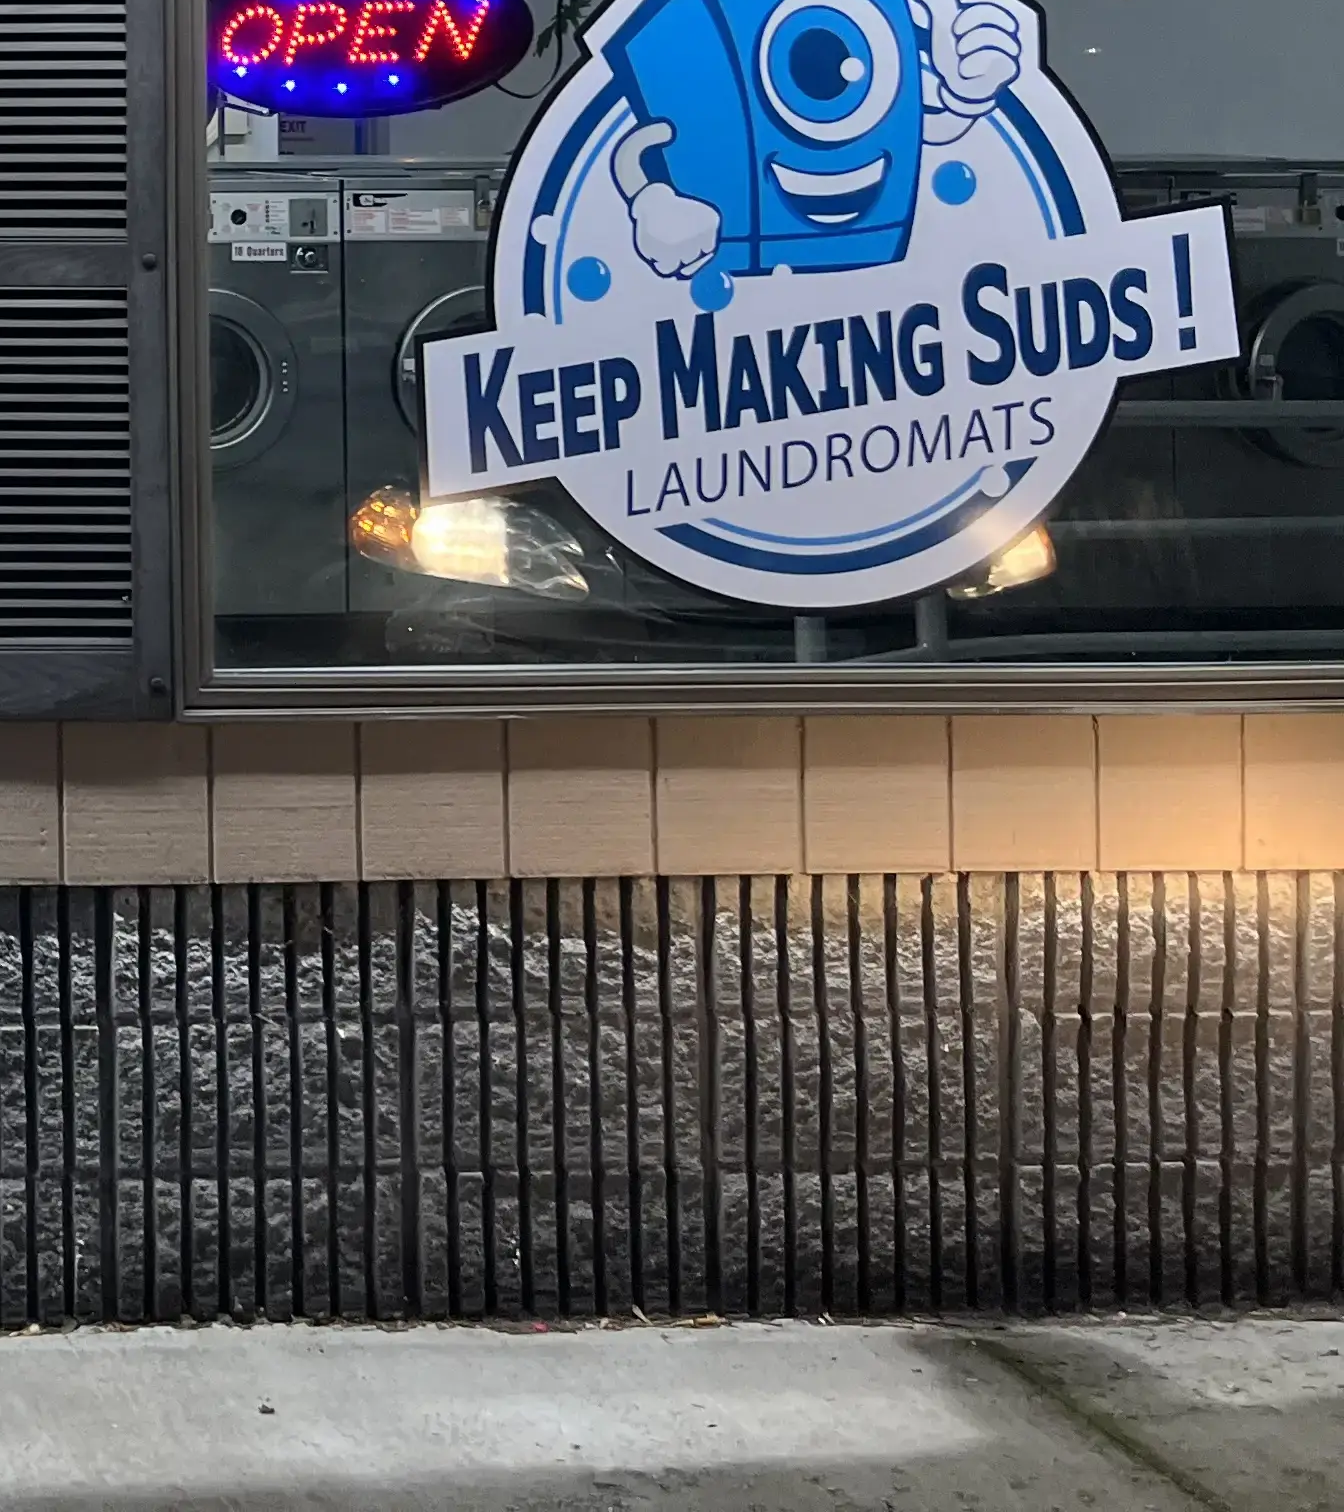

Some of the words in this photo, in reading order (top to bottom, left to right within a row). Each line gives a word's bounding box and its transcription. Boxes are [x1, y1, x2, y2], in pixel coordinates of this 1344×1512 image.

[221, 0, 491, 66] OPEN
[246, 245, 284, 257] Quarters
[464, 347, 641, 474] KEEP
[656, 303, 945, 441] MAKING
[624, 396, 1056, 518] LAUNDROMATS
